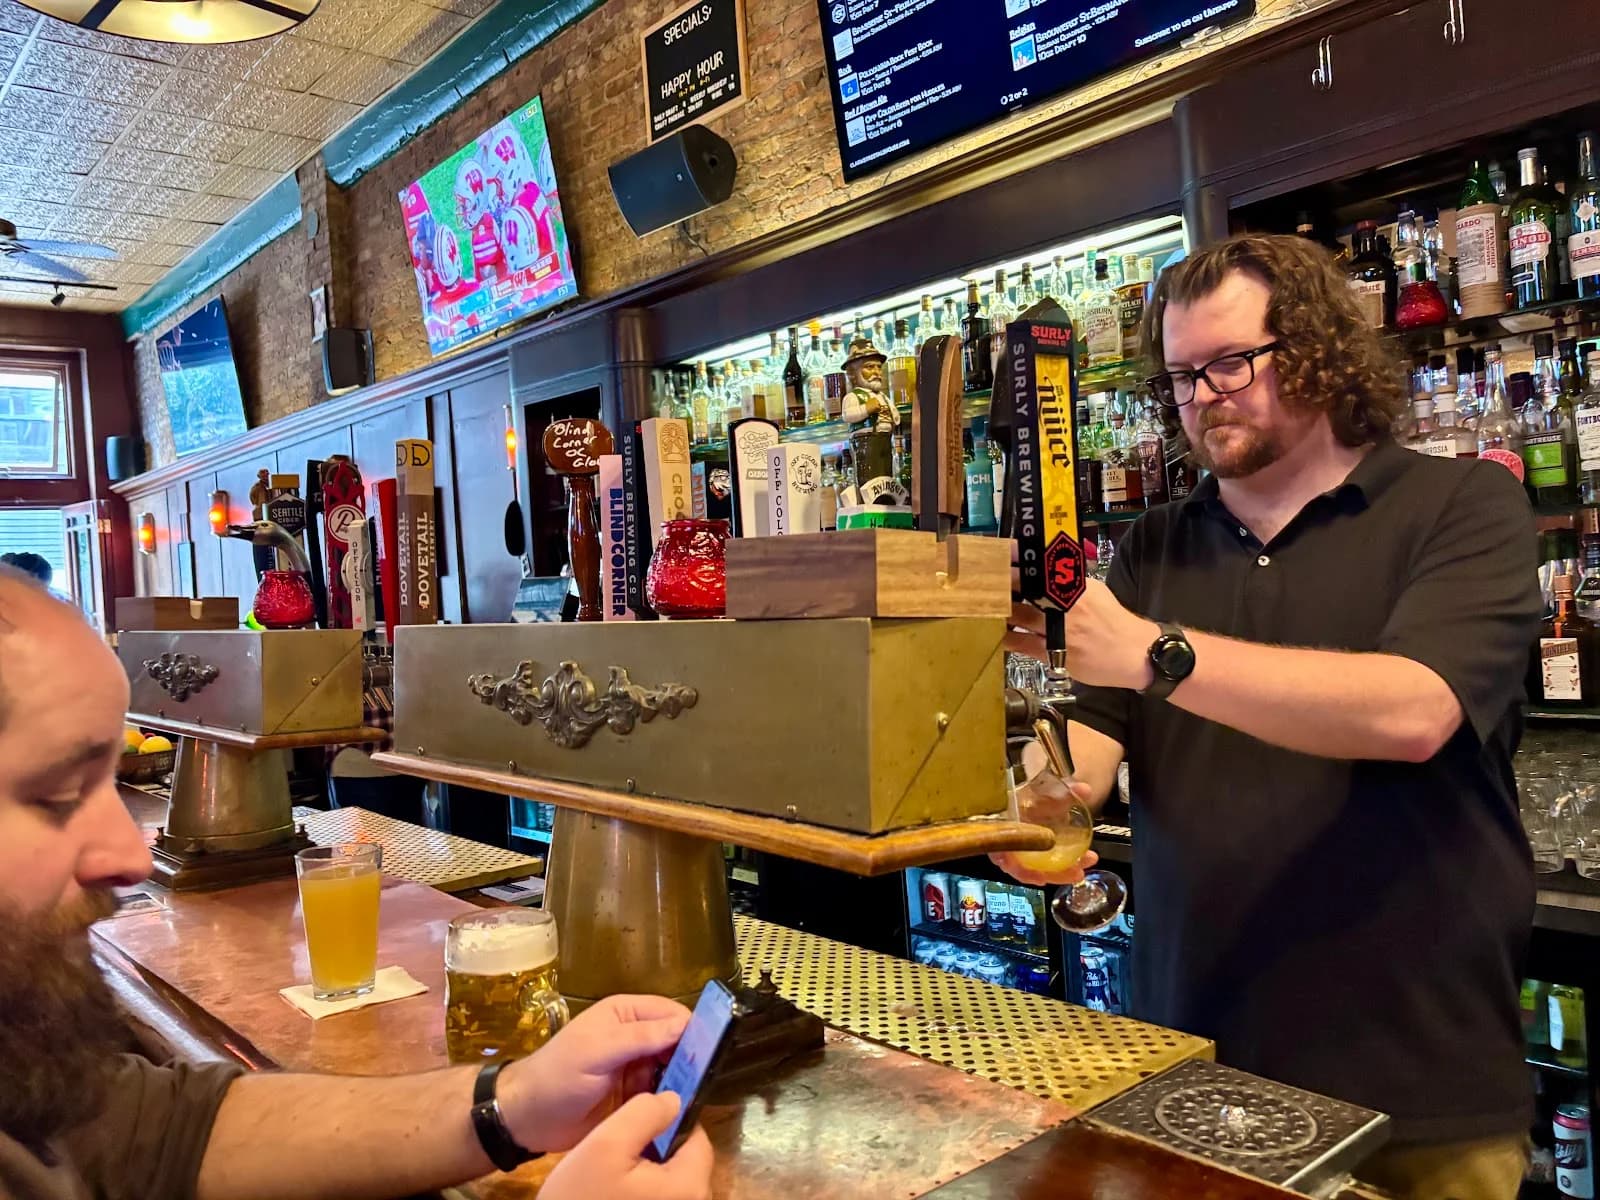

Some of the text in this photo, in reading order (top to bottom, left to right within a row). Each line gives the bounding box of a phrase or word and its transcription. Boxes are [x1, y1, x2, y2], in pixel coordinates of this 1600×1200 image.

[1171, 23, 1181, 32] TO
[661, 69, 692, 99] HAPPY
[697, 51, 724, 79] HOUR
[1031, 325, 1072, 340] SURLY
[1012, 343, 1028, 417] SURLY
[553, 421, 595, 436] Blind
[553, 434, 598, 449] Corner
[624, 433, 633, 486] SURLY
[773, 456, 782, 491] OFF
[1016, 426, 1036, 538] BREWING
[272, 507, 304, 518] SEATTLE
[624, 492, 636, 568] BREWING
[398, 512, 409, 606] DOVETAIL
[416, 511, 430, 607] DOVETAIL
